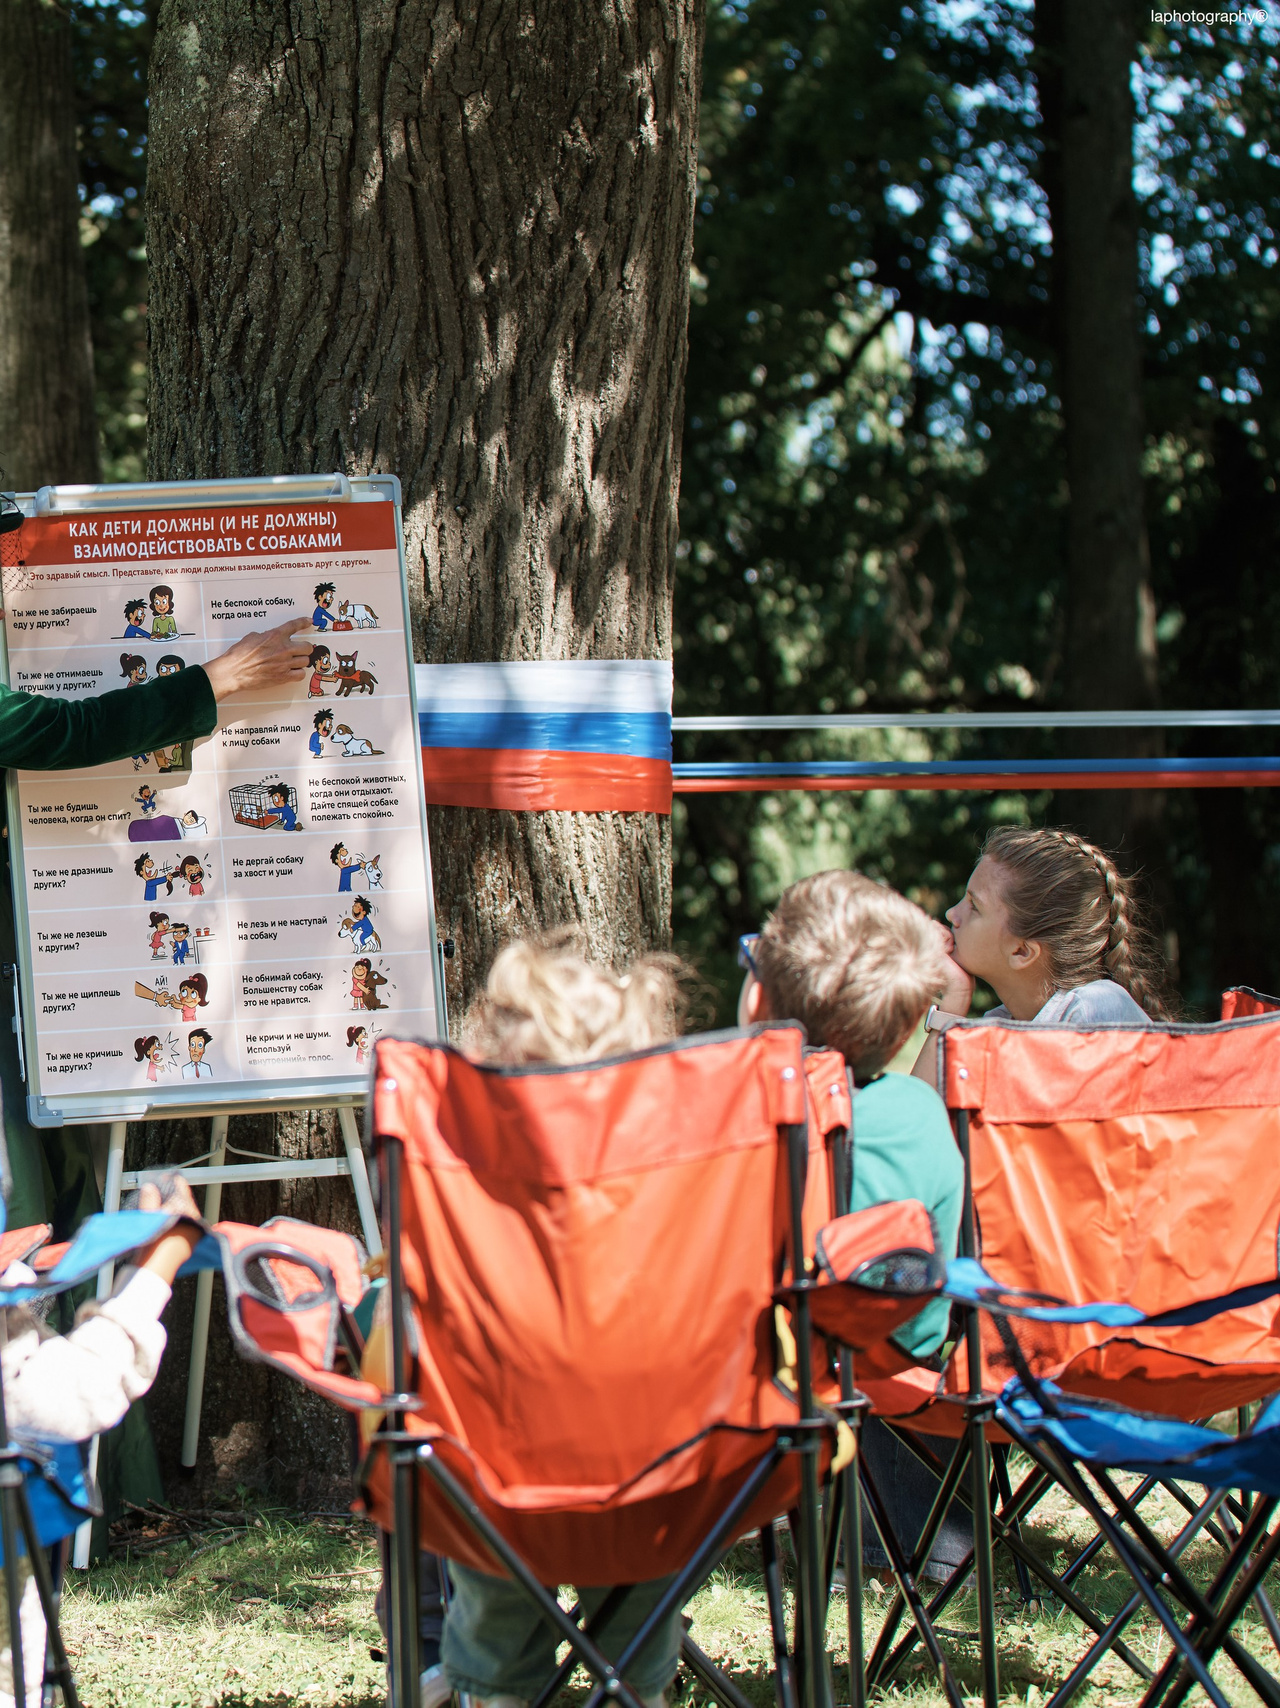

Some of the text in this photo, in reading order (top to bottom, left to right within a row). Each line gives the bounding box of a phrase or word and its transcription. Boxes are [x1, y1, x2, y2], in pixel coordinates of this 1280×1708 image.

[69, 511, 337, 538] КАК ДЕТИ ДОЛЖНЫ (И НЕ ДОЛЖНЫ)
[74, 533, 341, 559] ВЗАИМОДЕЙСТВОВАТЬ С СОБАКАМИ
[30, 572, 44, 580] Это
[46, 570, 81, 581] здравый
[83, 570, 110, 578] смысл.
[113, 568, 163, 578] Представьте,
[181, 566, 201, 574] люди
[204, 565, 236, 574] должны
[238, 561, 313, 571] взаимодействовать
[315, 560, 333, 569] друг
[341, 559, 371, 568] другом.
[224, 598, 263, 608] беспокой
[265, 598, 295, 606] собаку,
[12, 609, 23, 617] Ты
[51, 607, 97, 616] забираешь
[30, 622, 34, 630] у
[37, 619, 70, 629] других?
[17, 672, 28, 680] Ты
[56, 670, 103, 678] отнимаешь
[18, 684, 54, 693] игрушки
[63, 681, 96, 691] других?
[235, 725, 278, 736] направляй
[280, 725, 301, 733] лицо
[229, 739, 249, 748] лицу
[252, 737, 280, 745] собаки
[308, 775, 406, 787] Не беспокой животных,
[334, 789, 350, 797] они
[351, 787, 393, 797] отдыхают.
[28, 805, 39, 813] Ты
[66, 803, 98, 812] будишь
[311, 799, 399, 811] Дайте спящей собаке
[28, 816, 69, 825] человека,
[108, 812, 131, 821] спит?
[311, 810, 394, 822] полежать спокойно.
[246, 857, 274, 866] дергай
[276, 855, 304, 865] собаку
[33, 869, 44, 877] Ты
[71, 867, 113, 876] дразнишь
[276, 868, 293, 877] уши
[34, 880, 66, 890] других?
[250, 920, 269, 928] лезь
[290, 917, 327, 927] наступай
[37, 932, 48, 940] Ты
[250, 931, 278, 941] собаку
[45, 943, 79, 953] другим?
[155, 976, 168, 986] АЙ!
[242, 972, 323, 983] Не обнимай собаку.
[243, 983, 323, 995] Большенству собак
[42, 992, 53, 1001] Ты
[81, 991, 120, 1000] щиплешь
[271, 996, 311, 1006] нравится.
[43, 1004, 75, 1013] других?
[246, 1035, 257, 1043] Не
[259, 1034, 284, 1043] кричи
[306, 1031, 331, 1040] шуми.
[247, 1045, 291, 1054] Используй
[46, 1052, 57, 1060] Ты
[86, 1050, 123, 1060] кричишь
[308, 1054, 333, 1062] голос.
[59, 1063, 92, 1073] других?
